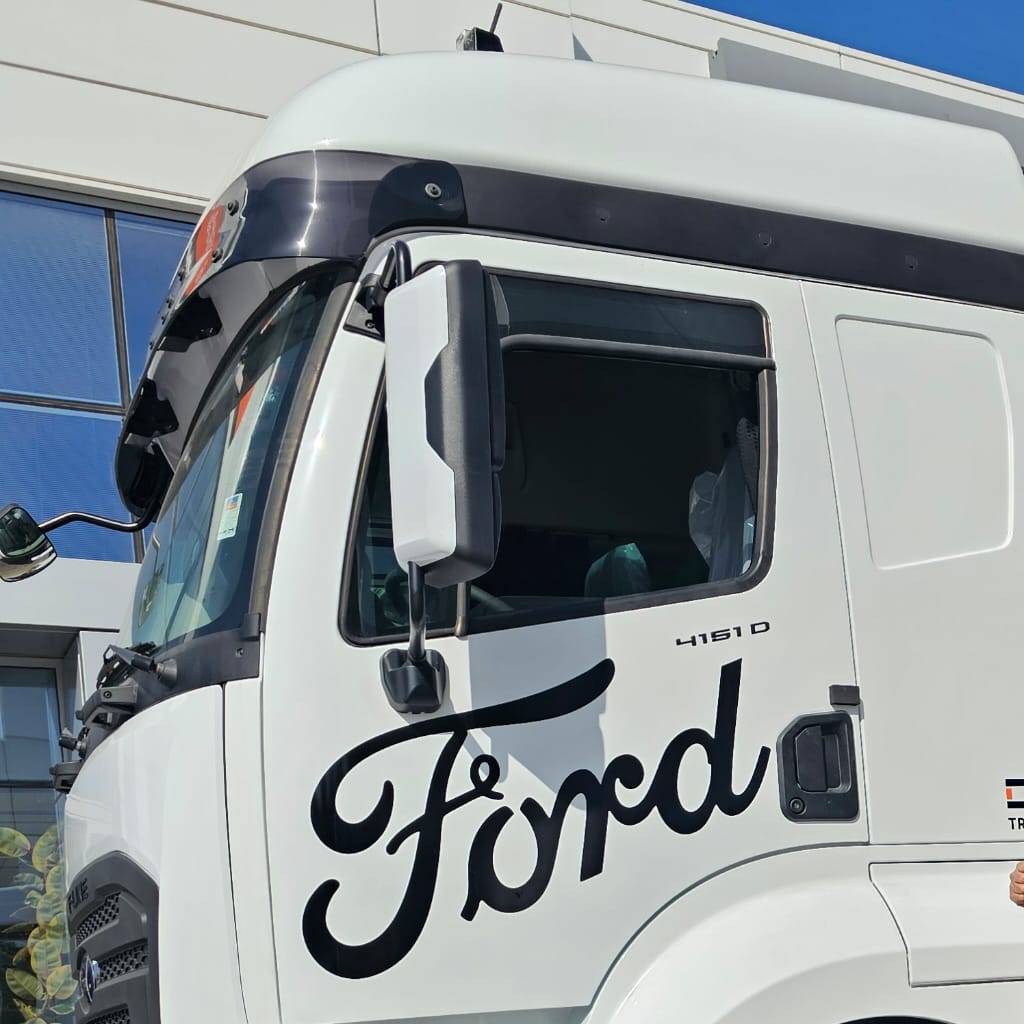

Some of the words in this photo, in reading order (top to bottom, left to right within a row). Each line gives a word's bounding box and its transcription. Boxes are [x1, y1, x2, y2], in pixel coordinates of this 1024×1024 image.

[676, 625, 741, 647] 4151
[750, 621, 770, 635] D
[301, 658, 771, 979] Ford
